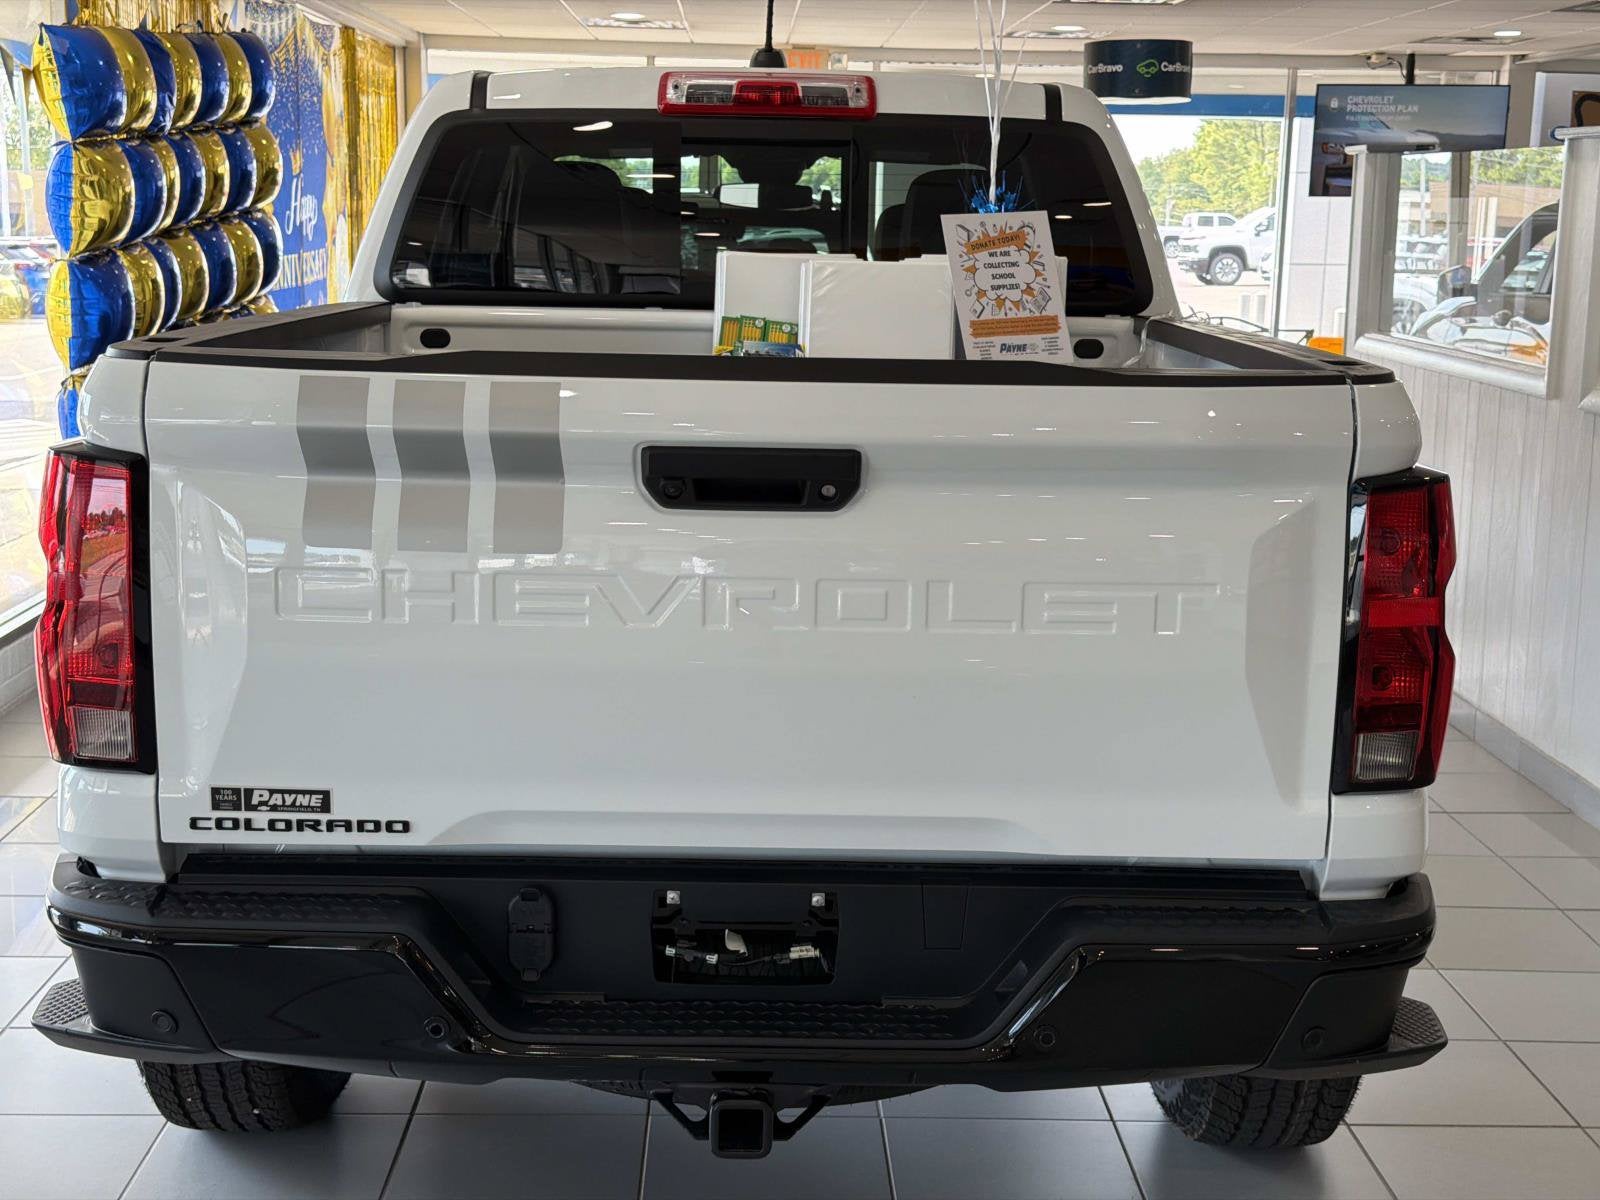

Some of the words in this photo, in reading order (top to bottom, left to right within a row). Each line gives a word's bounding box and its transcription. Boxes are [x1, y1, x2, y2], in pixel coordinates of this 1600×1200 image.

[1087, 63, 1123, 74] CarBravo
[1347, 96, 1394, 104] CHEVROLET
[1346, 105, 1396, 113] PROTECTION
[285, 173, 318, 241] Happy
[970, 240, 996, 250] DONATE
[997, 234, 1021, 245] TODAY!
[983, 261, 1020, 269] COLLECTING
[990, 283, 1021, 291] SUPPLIES!
[1000, 343, 1027, 353] PAYNE
[275, 567, 1219, 635] CHEVROLET
[251, 790, 323, 807] PAYNE
[189, 817, 410, 834] COLORADO
